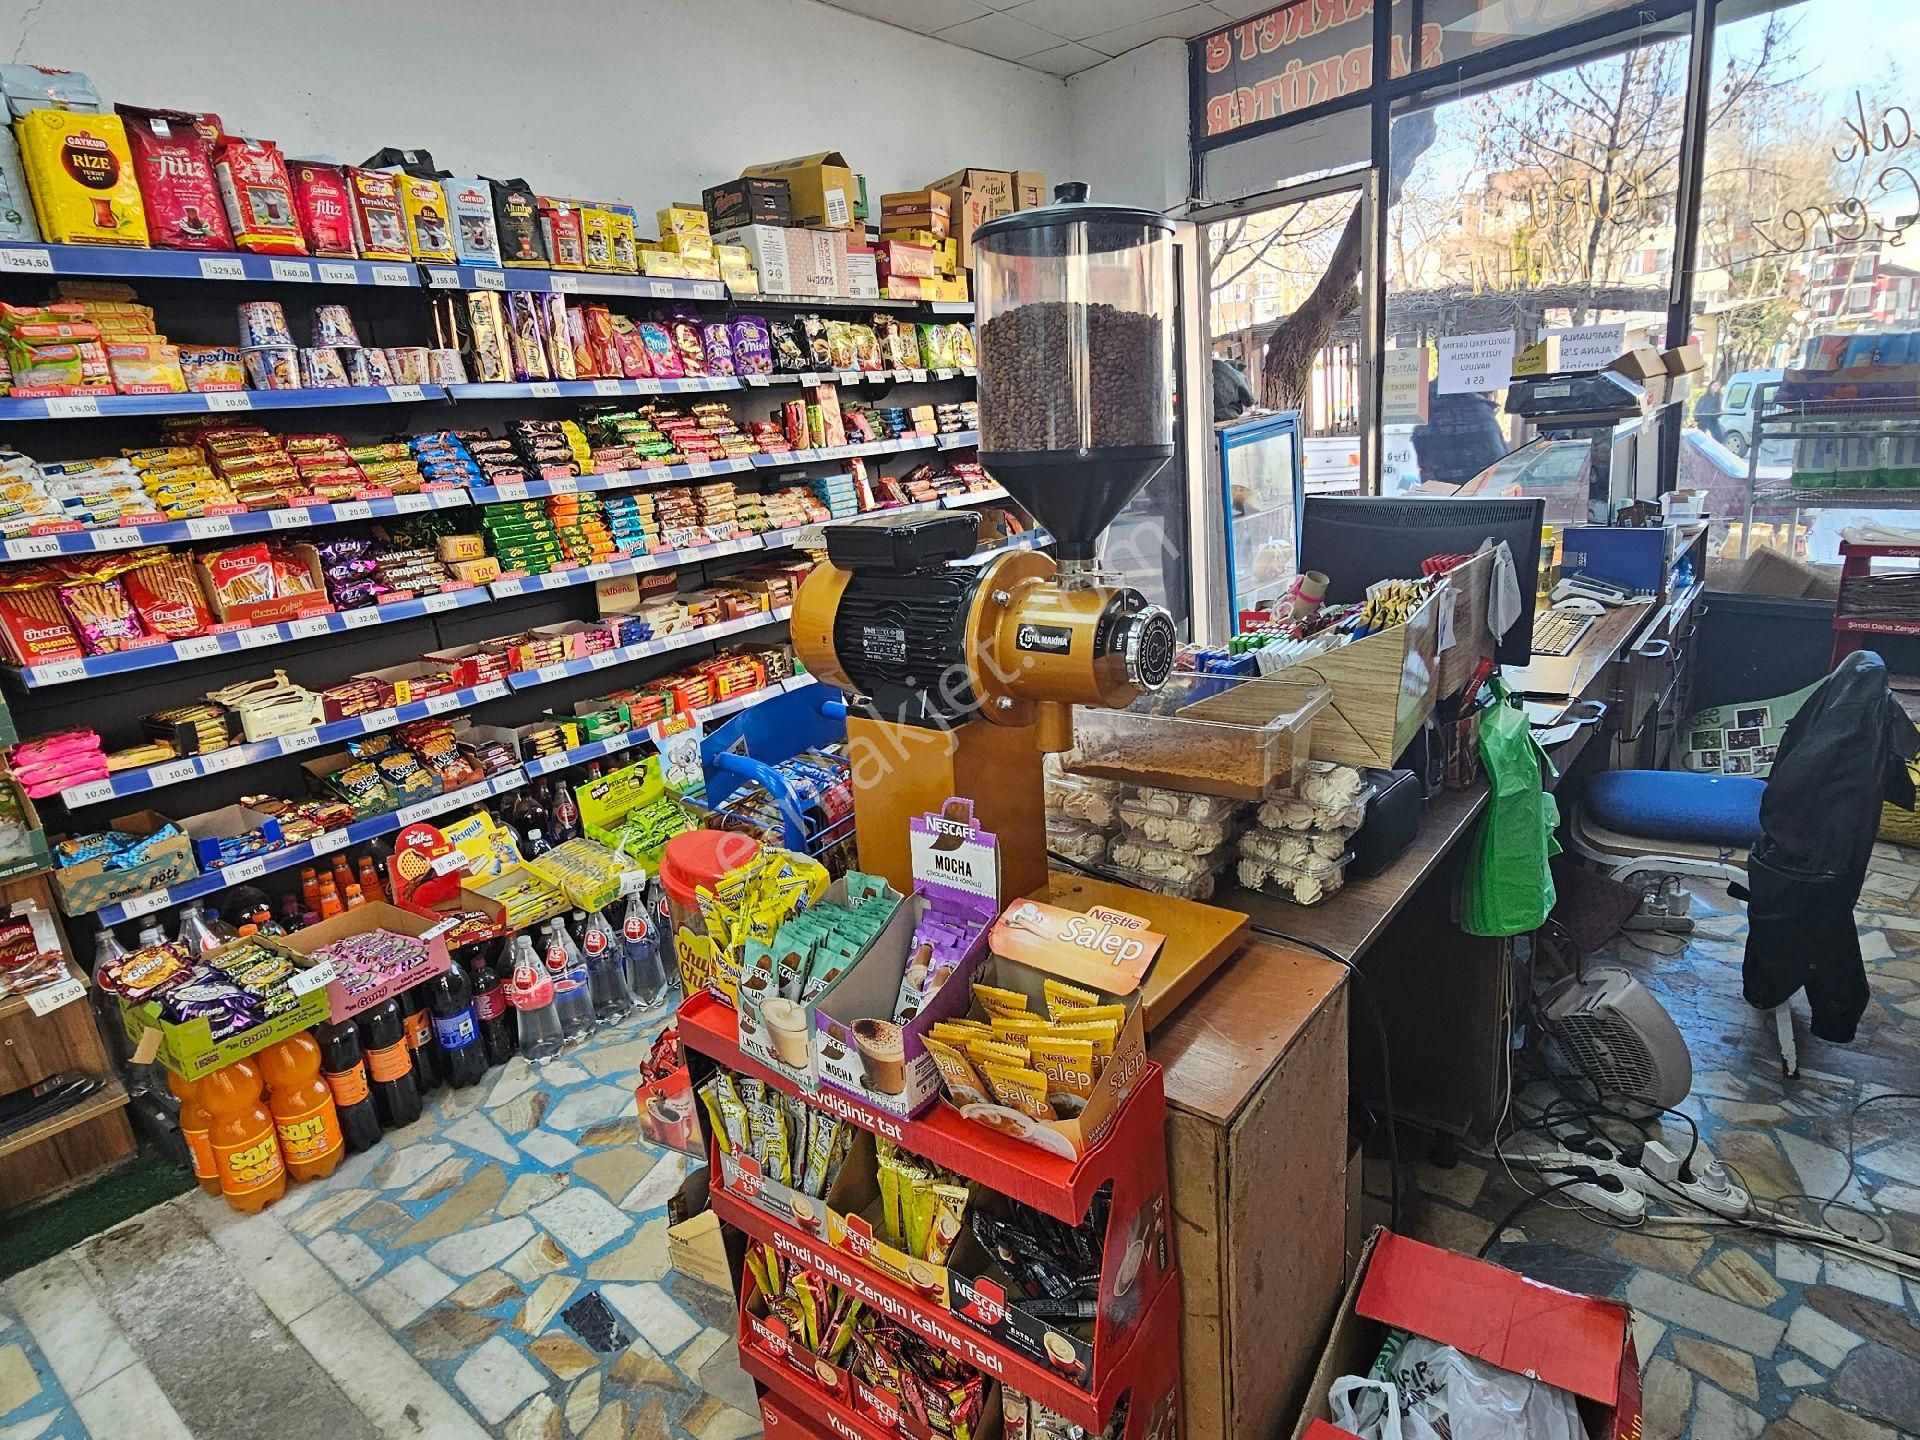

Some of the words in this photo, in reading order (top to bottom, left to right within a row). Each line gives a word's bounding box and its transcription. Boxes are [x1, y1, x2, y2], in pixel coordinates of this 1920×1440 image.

[71, 153, 111, 170] RİZE
[157, 155, 207, 181] filiz
[314, 200, 342, 217] filiz
[11, 256, 50, 269] 294,50
[213, 266, 242, 277] 329,50
[225, 399, 249, 407] 10,00
[206, 524, 230, 533] 11,00
[113, 534, 140, 544] 11,00
[29, 543, 59, 553] 11,00
[219, 556, 257, 569] ÜLKER
[23, 626, 71, 642] ÜLKER
[311, 623, 328, 632] 5,00
[1847, 621, 1871, 630] Şimdi
[1871, 623, 1893, 632] Daha
[29, 637, 76, 653] Susamlı
[56, 667, 84, 678] 10,00
[377, 715, 397, 725] 25,00
[296, 735, 318, 746] 25,00
[169, 767, 194, 779] 10,00
[84, 787, 112, 800] 10,00
[412, 809, 431, 820] 10,00
[451, 819, 483, 844] Nesquik
[332, 837, 348, 847] 7,00
[240, 864, 264, 877] 30,00
[935, 855, 973, 878] MOCHA
[150, 865, 181, 890] pöti
[148, 896, 169, 908] 9,00
[1058, 917, 1144, 966] Salep
[130, 955, 164, 981] Gong
[309, 969, 334, 986] 16,50
[51, 984, 82, 1004] 37,50
[359, 986, 388, 1008] Gong
[199, 1005, 225, 1018] Gong
[211, 1025, 235, 1040] Gong
[241, 1026, 272, 1049] Gong
[824, 1060, 854, 1084] MOCHA
[1035, 1062, 1092, 1091] Salep
[1110, 1051, 1145, 1096] Salep
[995, 1083, 1049, 1116] Salep
[799, 1084, 877, 1127] Sevdiğiniz
[875, 1116, 904, 1142] tat
[773, 1231, 812, 1264] Şimdi
[814, 1254, 853, 1288] Daha
[854, 1277, 907, 1322] Zengin
[911, 1310, 961, 1352] Kahve
[965, 1340, 1003, 1374] Tadı
[1010, 1327, 1036, 1346] EXTRA
